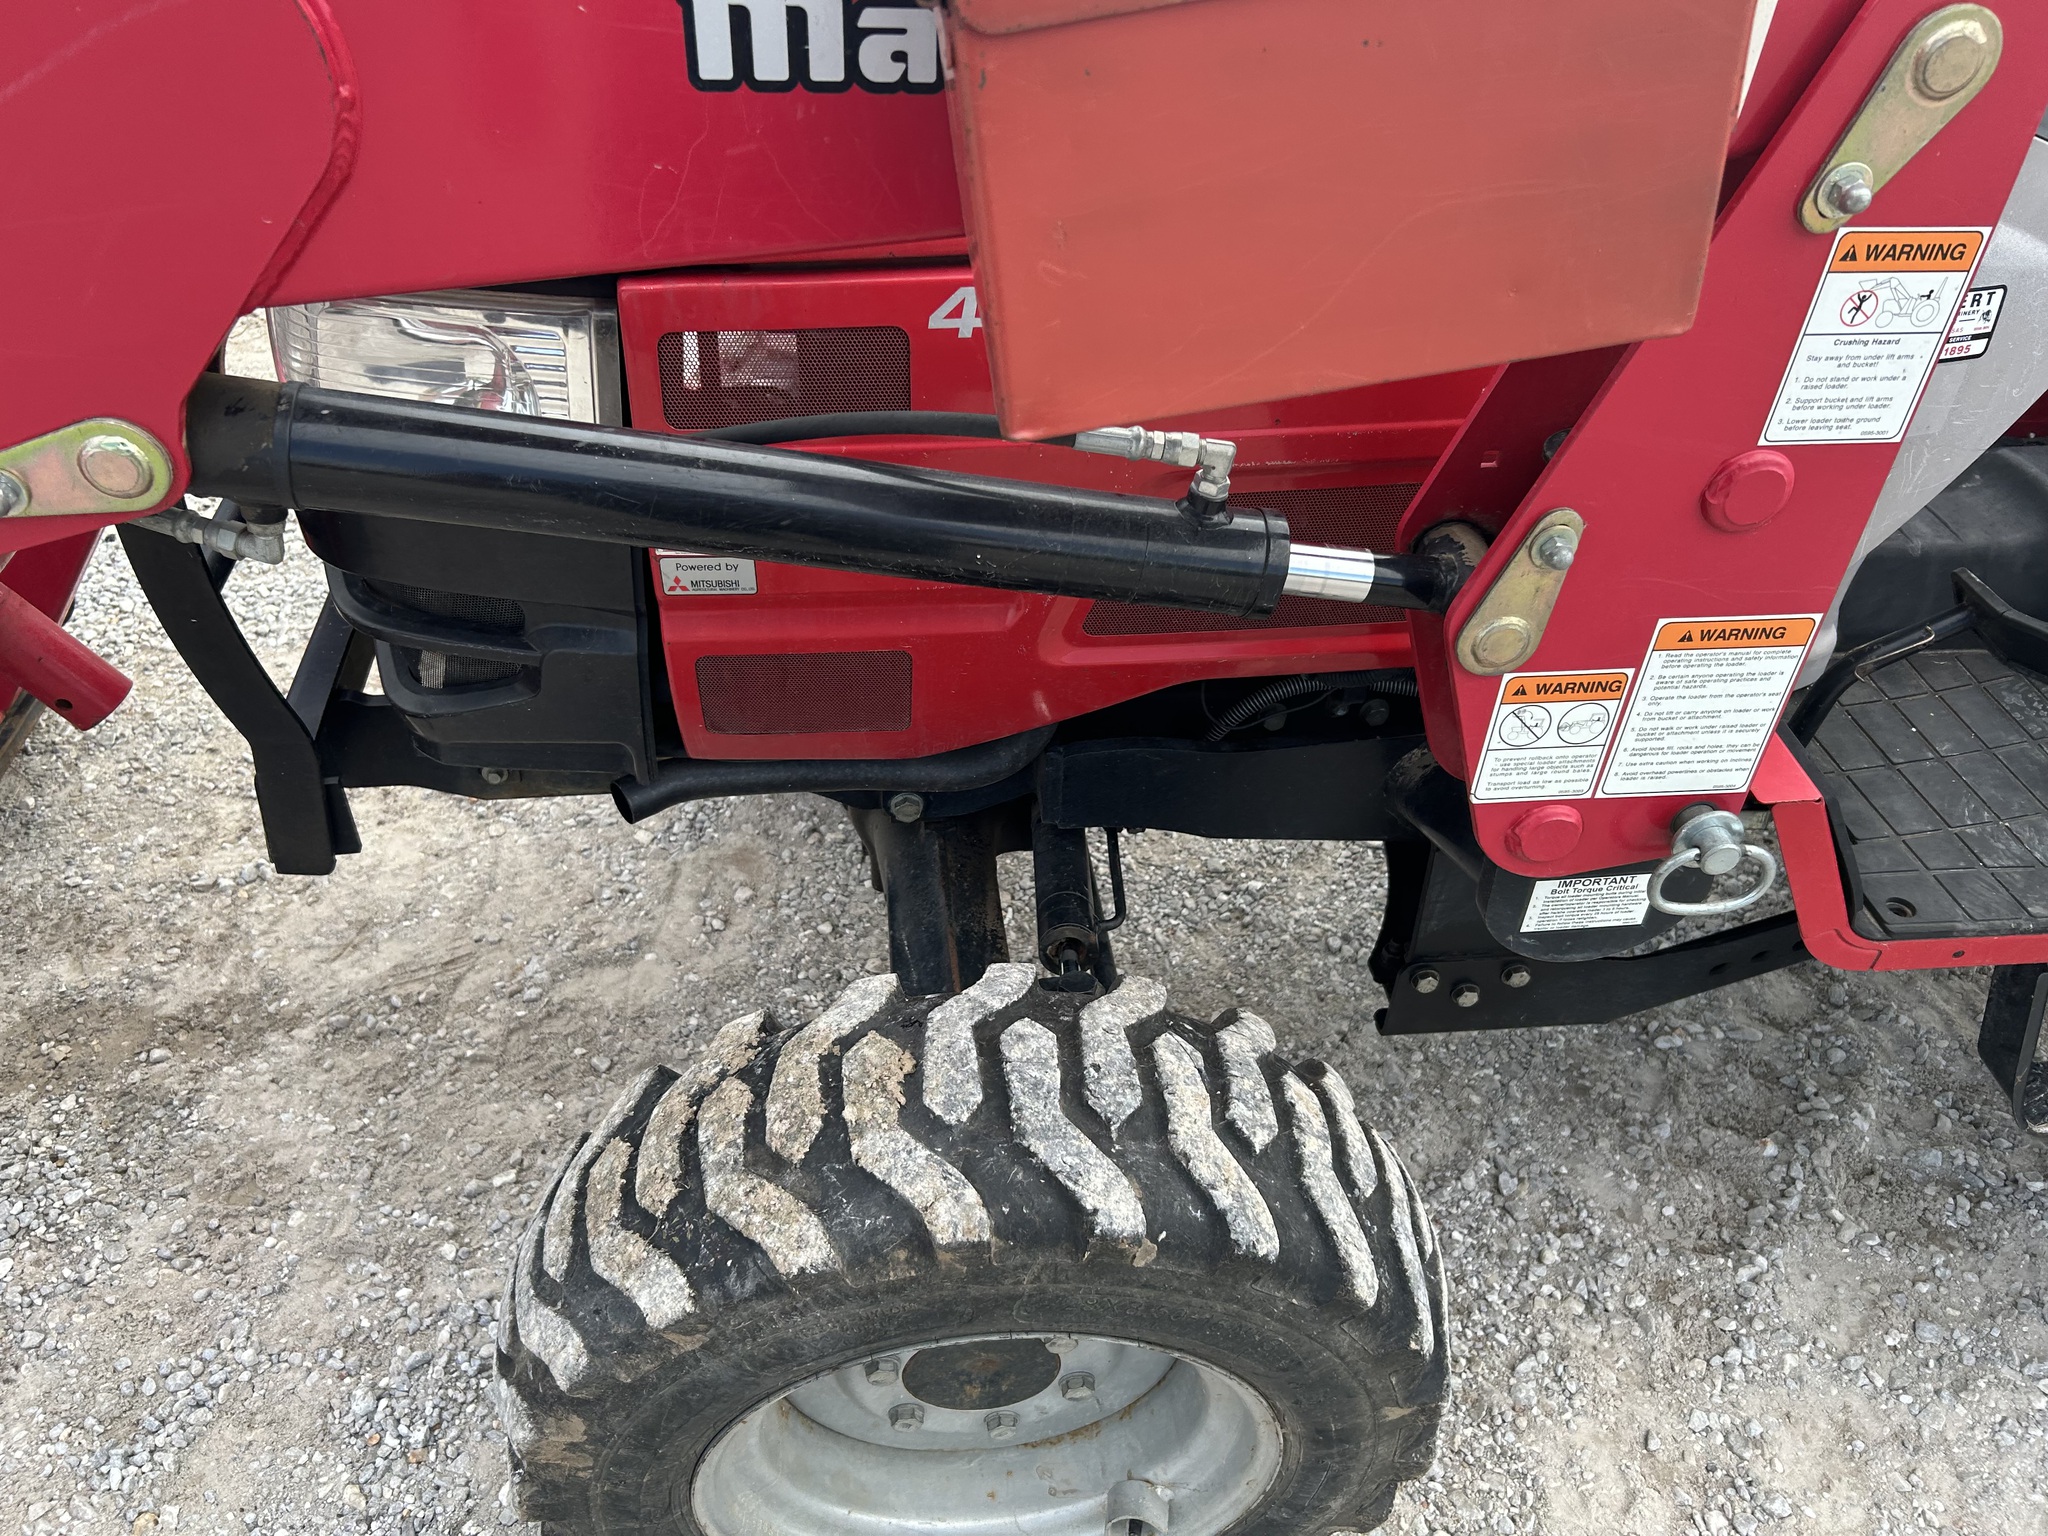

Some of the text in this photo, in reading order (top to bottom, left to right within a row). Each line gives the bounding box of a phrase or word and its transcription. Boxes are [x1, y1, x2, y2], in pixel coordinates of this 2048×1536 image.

[1865, 243, 1966, 261] WARNING
[928, 286, 983, 338] 4
[1833, 338, 1870, 346] Crushing
[1944, 344, 1972, 357] 1895
[1806, 354, 1823, 362] Stay
[675, 562, 739, 572] Powered by
[690, 579, 740, 588] MITSUBISHI
[1700, 626, 1786, 642] WARNING
[1536, 680, 1622, 695] WARNING
[1558, 876, 1637, 888] IMPORTANT
[1605, 883, 1639, 891] Critical
